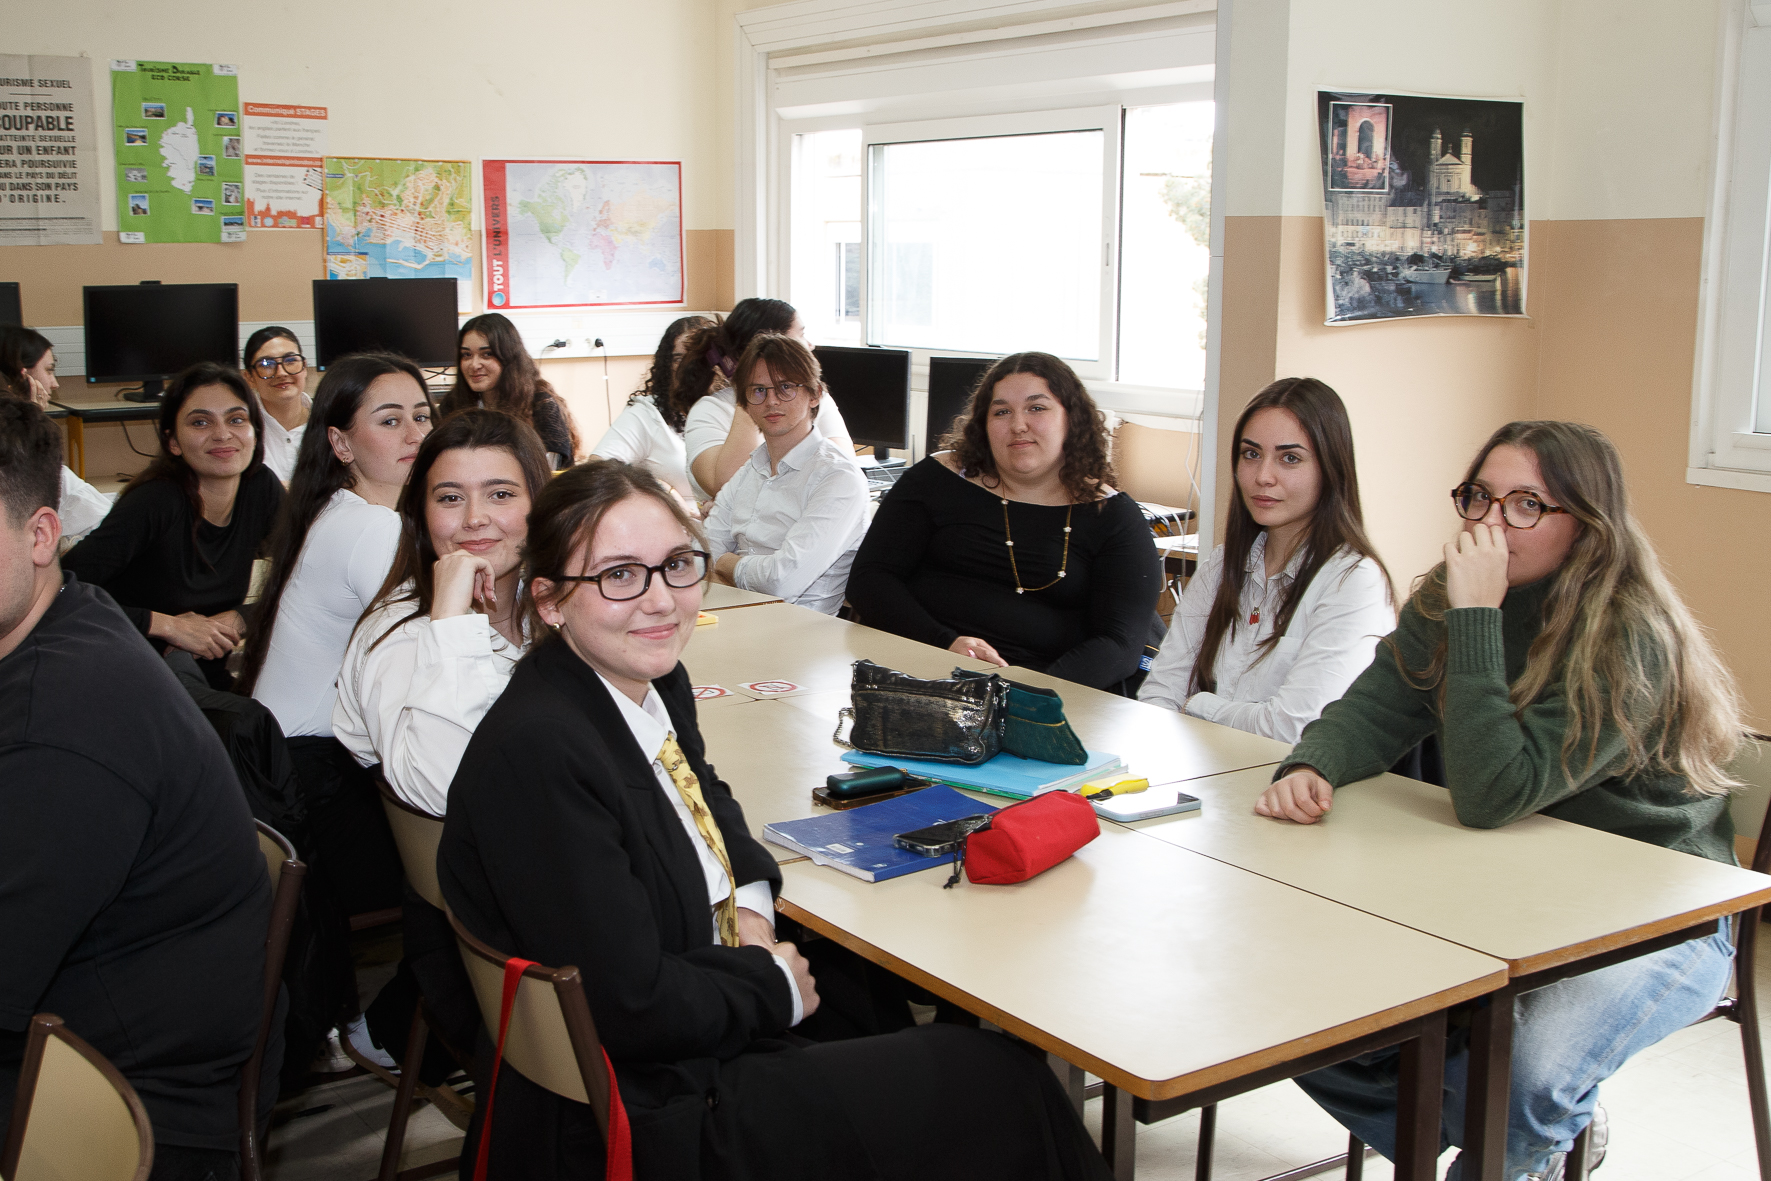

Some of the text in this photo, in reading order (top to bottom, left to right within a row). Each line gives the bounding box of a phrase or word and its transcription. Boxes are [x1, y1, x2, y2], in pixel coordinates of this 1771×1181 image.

[37, 78, 72, 89] SEXUEL
[23, 101, 74, 112] PERSONNE
[296, 108, 326, 116] STAGES
[0, 113, 75, 131] OUPABLE
[38, 134, 76, 143] SEXUELLE
[17, 145, 33, 155] UN
[35, 145, 77, 156] ENFANT
[21, 159, 78, 169] POURSUIVIE
[15, 171, 24, 179] LE
[25, 171, 44, 179] PAYS
[45, 171, 56, 179] DU
[57, 169, 78, 179] DÉLIT
[9, 182, 33, 191] DANS
[35, 182, 53, 191] SON
[54, 182, 79, 191] PAYS
[491, 196, 504, 291] TOUT L'UNIVERS
